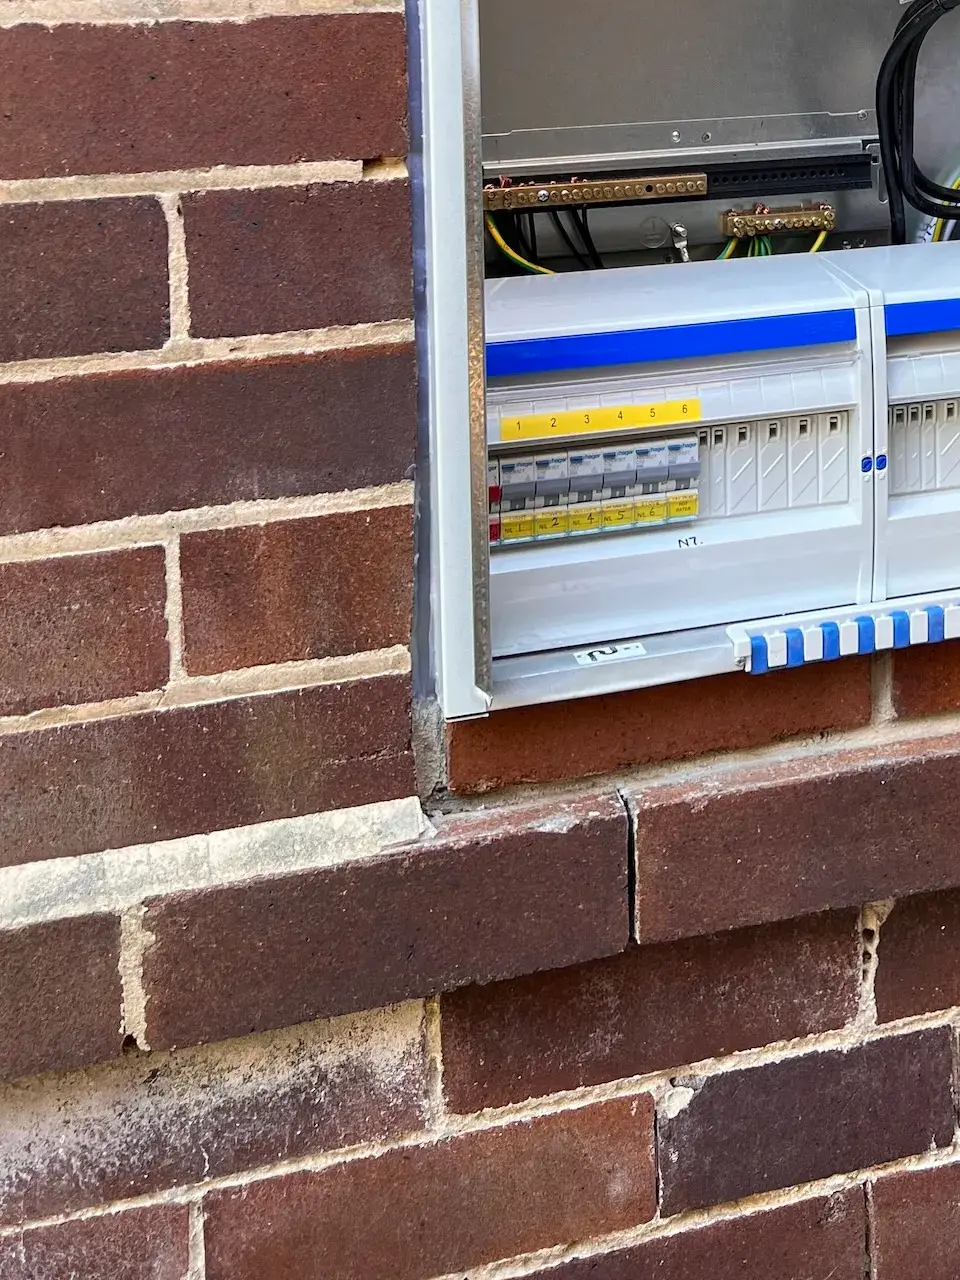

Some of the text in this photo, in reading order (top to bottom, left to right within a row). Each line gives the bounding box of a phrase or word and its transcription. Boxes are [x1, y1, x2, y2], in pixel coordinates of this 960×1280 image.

[517, 404, 688, 430] 1 2 3 4 5 6
[618, 511, 625, 519] 5
[650, 508, 655, 516] 6
[552, 517, 559, 526] 2
[587, 513, 594, 524] 4
